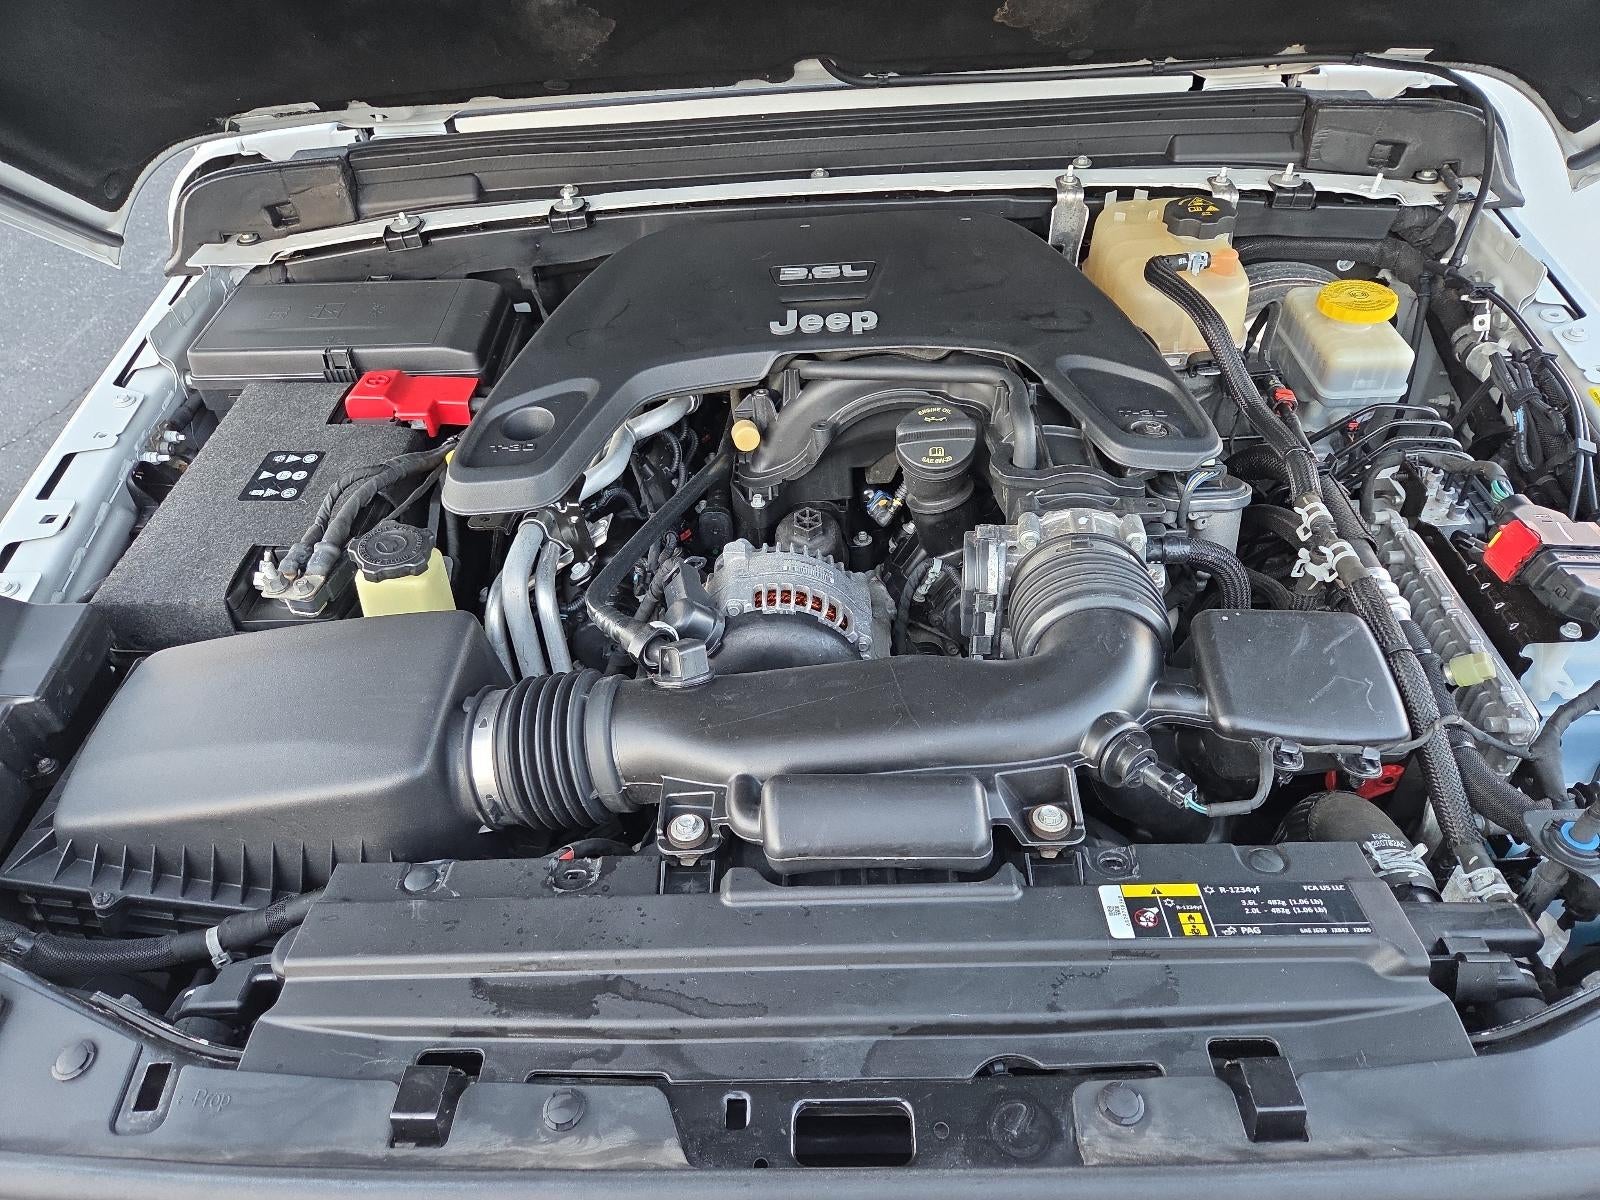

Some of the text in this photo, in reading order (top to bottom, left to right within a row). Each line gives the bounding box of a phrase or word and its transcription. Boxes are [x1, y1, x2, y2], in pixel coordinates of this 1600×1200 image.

[780, 264, 868, 281] 3.6L
[769, 309, 878, 336] Jeep
[917, 407, 952, 416] ENGINE OIL
[1219, 885, 1261, 895] R-1234yf
[1302, 884, 1319, 892] FCA
[1319, 884, 1331, 892] US
[1289, 898, 1310, 906] (1.06
[1311, 898, 1324, 906] Lb)
[1270, 907, 1291, 915] 482g
[1292, 907, 1314, 915] (1.06
[1315, 907, 1328, 915] Lb)
[1240, 926, 1262, 935] PAG
[191, 1087, 232, 1113] Prop
